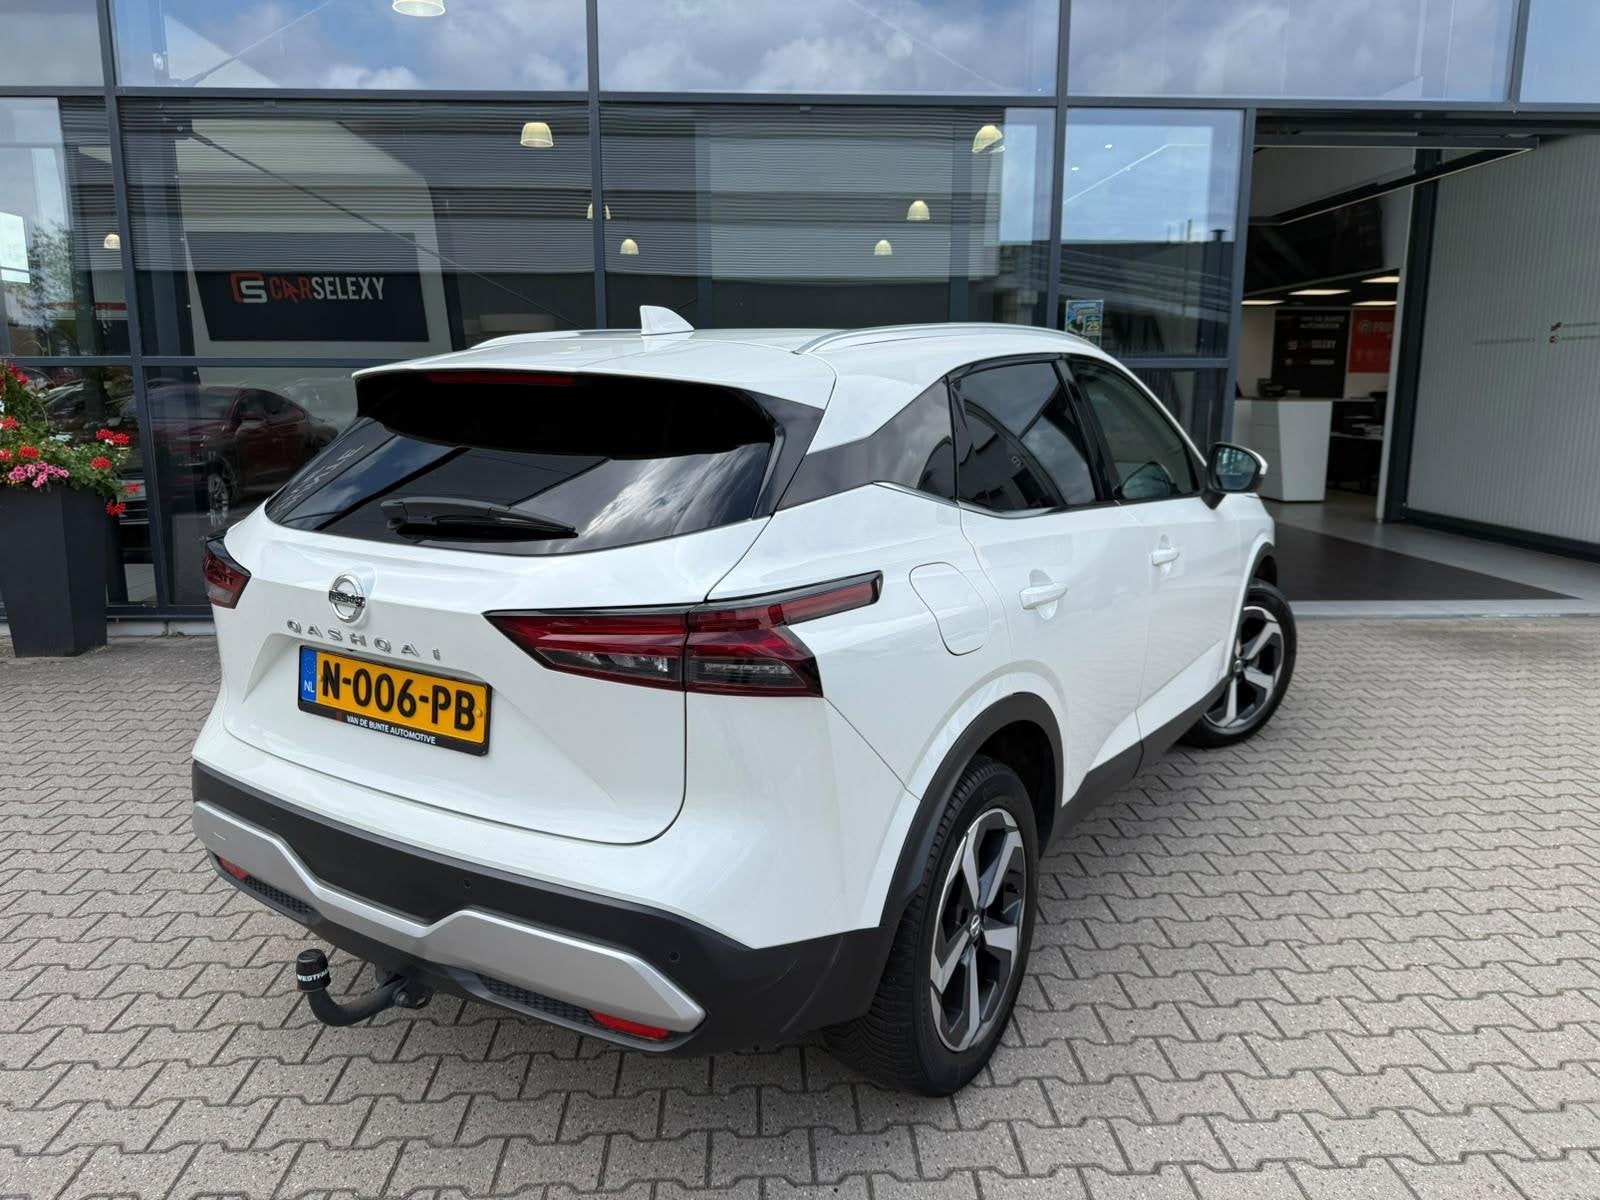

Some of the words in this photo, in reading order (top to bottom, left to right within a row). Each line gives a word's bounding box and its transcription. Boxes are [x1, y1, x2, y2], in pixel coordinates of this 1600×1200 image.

[286, 619, 441, 661] QASHQAI
[304, 681, 315, 692] NL
[323, 660, 475, 731] N-006-PB
[347, 715, 359, 725] VAN
[360, 719, 369, 727] DE
[369, 722, 389, 732] BUNTE
[390, 727, 436, 744] AUTOMOTIVE
